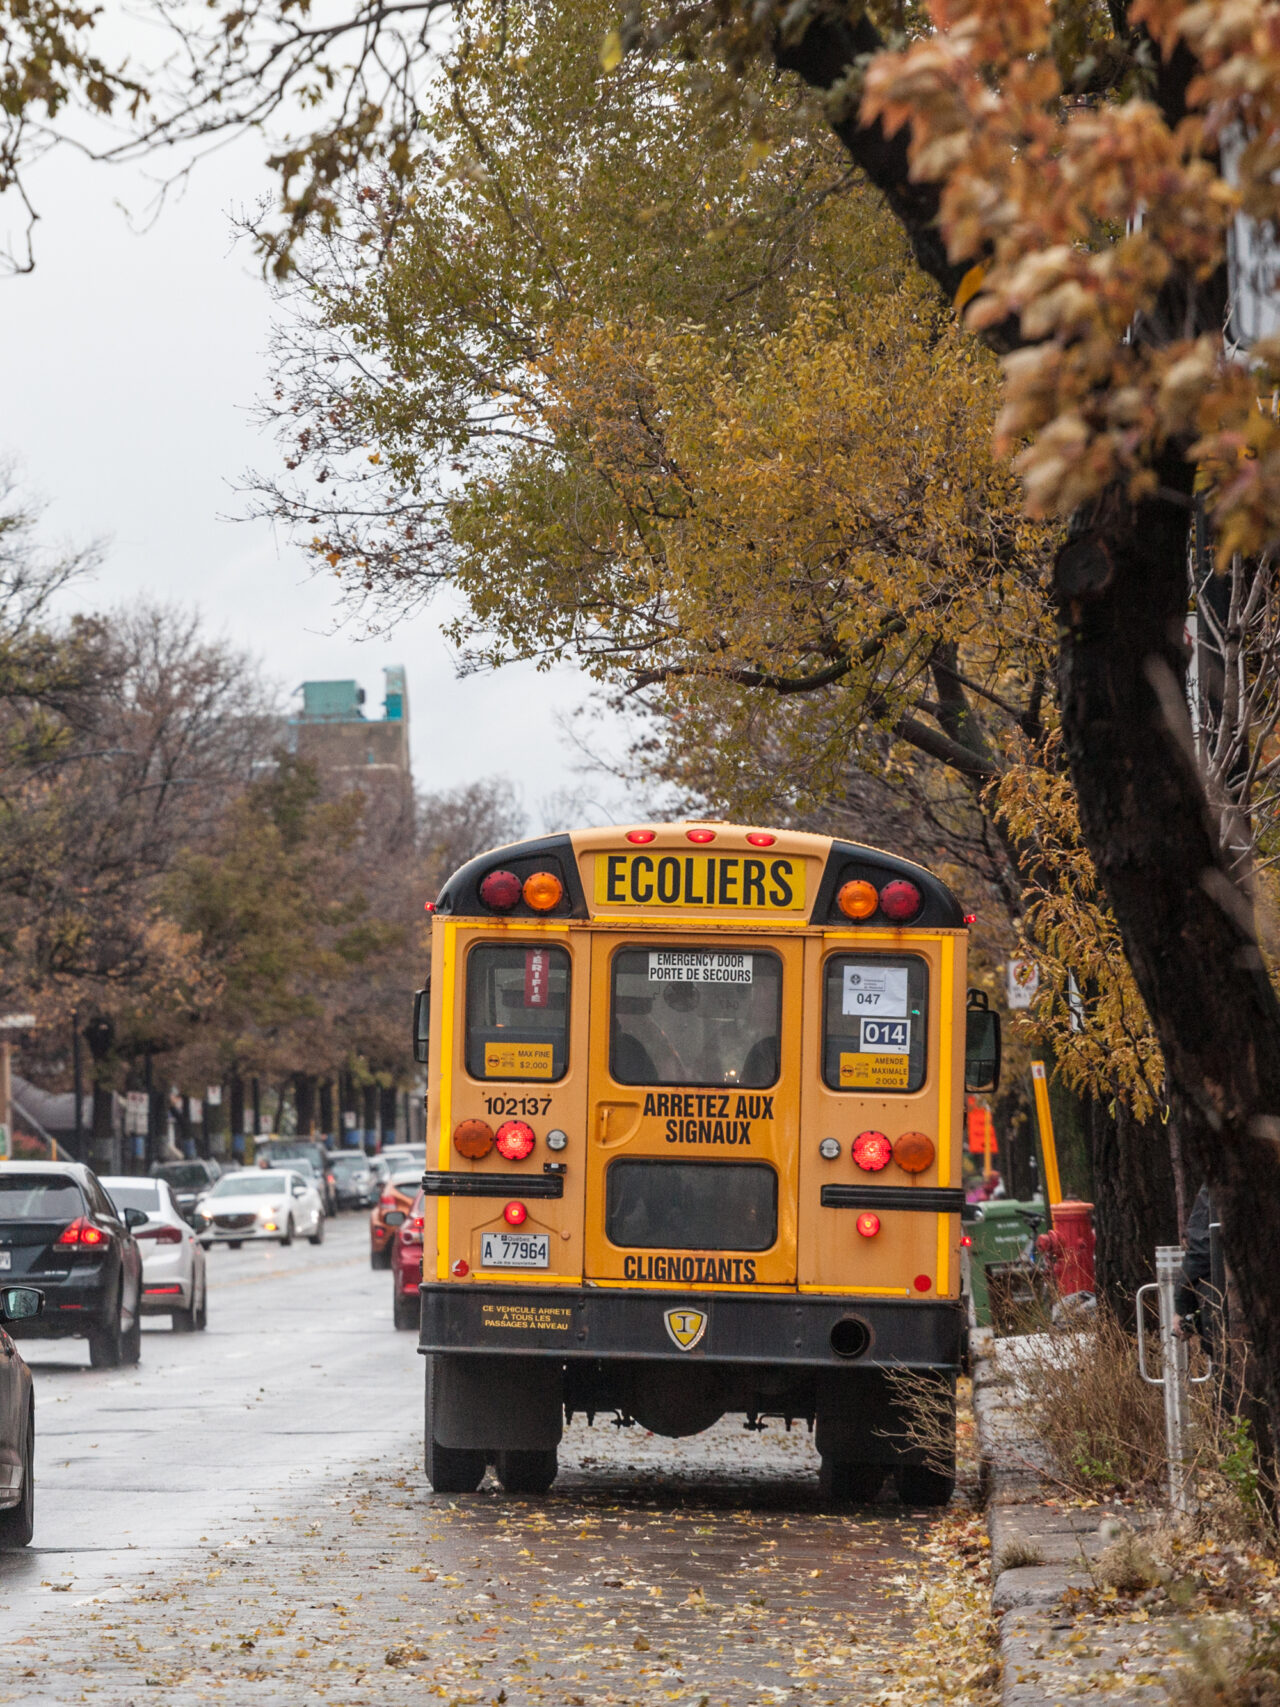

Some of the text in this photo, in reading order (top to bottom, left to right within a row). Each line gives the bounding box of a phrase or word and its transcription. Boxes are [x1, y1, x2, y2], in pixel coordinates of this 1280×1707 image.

[607, 855, 793, 907] ECOLIERS
[657, 953, 744, 968] EMERGENCY DOOR
[650, 967, 751, 982] PORTE DE SECOURS
[857, 993, 880, 1005] 047
[865, 1023, 905, 1044] 014
[875, 1057, 904, 1065] AMENDE
[871, 1067, 908, 1075] MAXIMALE
[484, 1097, 553, 1116] 102137
[643, 1093, 774, 1120] ARRETEZ AUX
[665, 1119, 751, 1145] SIGNAUX
[484, 1241, 546, 1260] A 77964
[624, 1255, 756, 1283] CLIGNOTANTS
[484, 1319, 528, 1329] PASSAGES
[537, 1322, 569, 1330] NIVEAU
[511, 1313, 533, 1321] TOUS
[535, 1314, 551, 1322] LES
